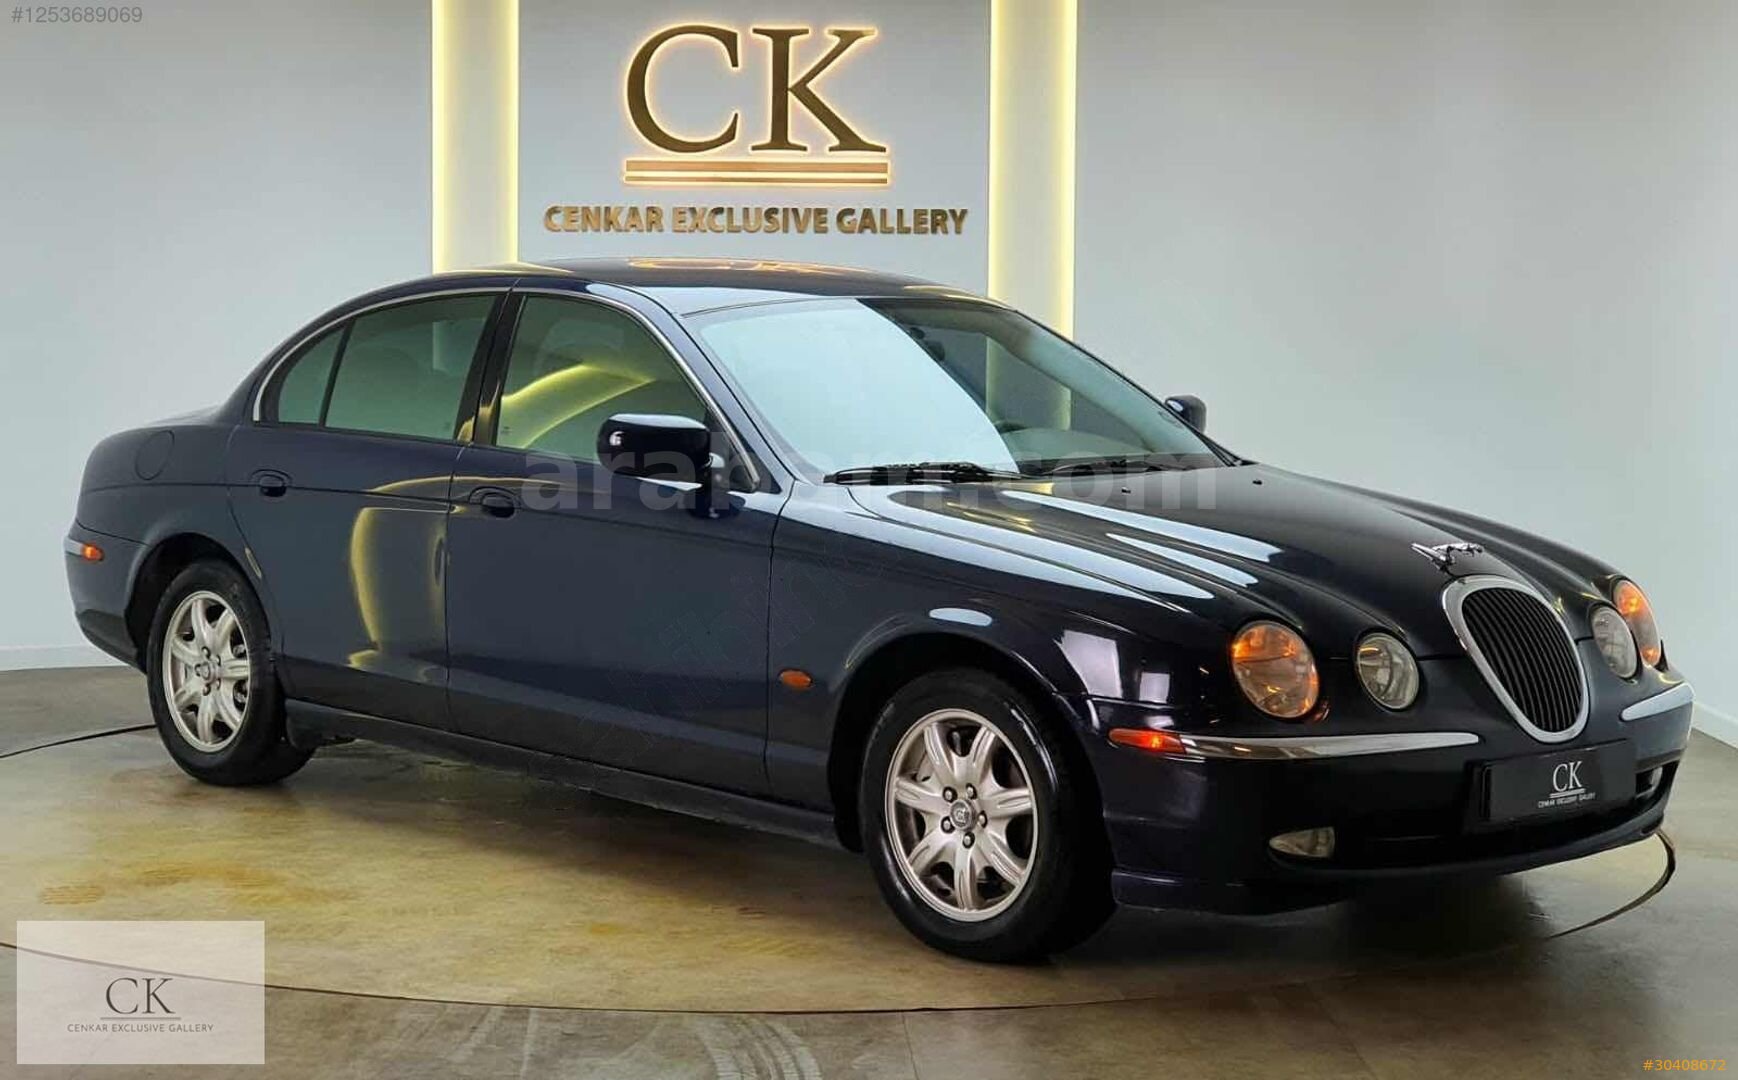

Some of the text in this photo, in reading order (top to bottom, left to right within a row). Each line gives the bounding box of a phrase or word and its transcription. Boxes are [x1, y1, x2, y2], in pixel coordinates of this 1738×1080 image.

[626, 24, 887, 154] CK
[543, 205, 969, 236] CENKAR EXCLUSIVE GALLERY
[1552, 760, 1583, 792] CK
